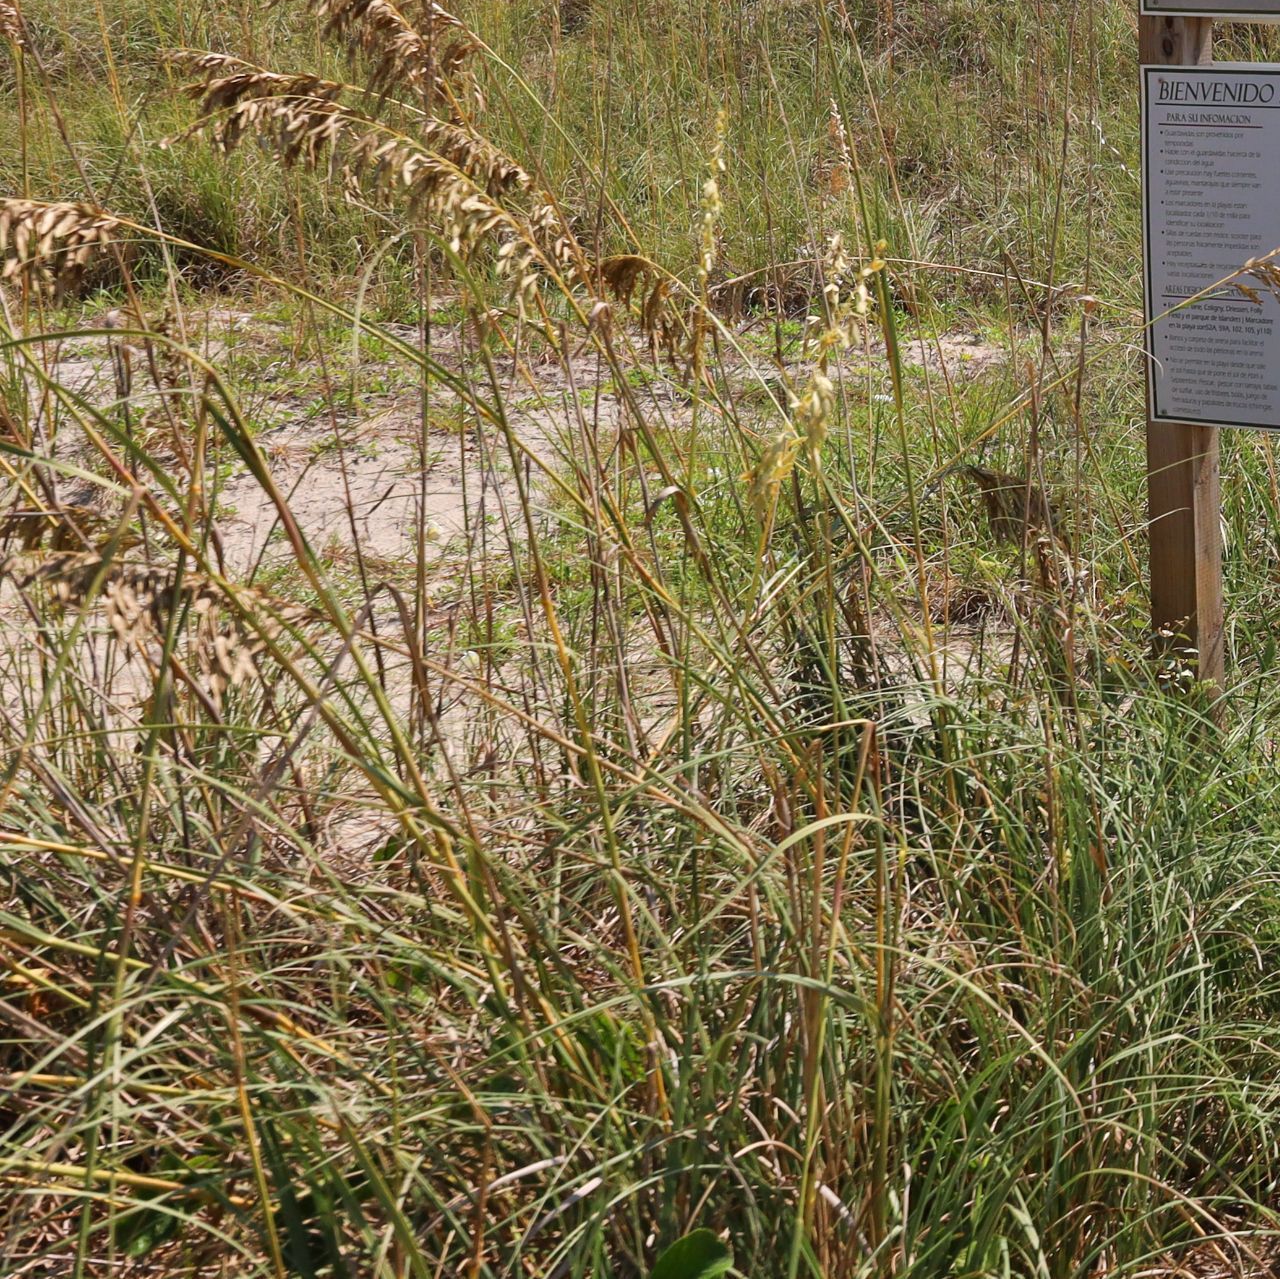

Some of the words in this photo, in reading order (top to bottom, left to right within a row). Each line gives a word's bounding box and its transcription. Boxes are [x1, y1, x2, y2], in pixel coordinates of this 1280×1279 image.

[1159, 81, 1274, 103] BIENVENIDO
[1166, 113, 1186, 122] PARA
[1188, 114, 1198, 122] SU
[1200, 114, 1251, 124] INFOMACION
